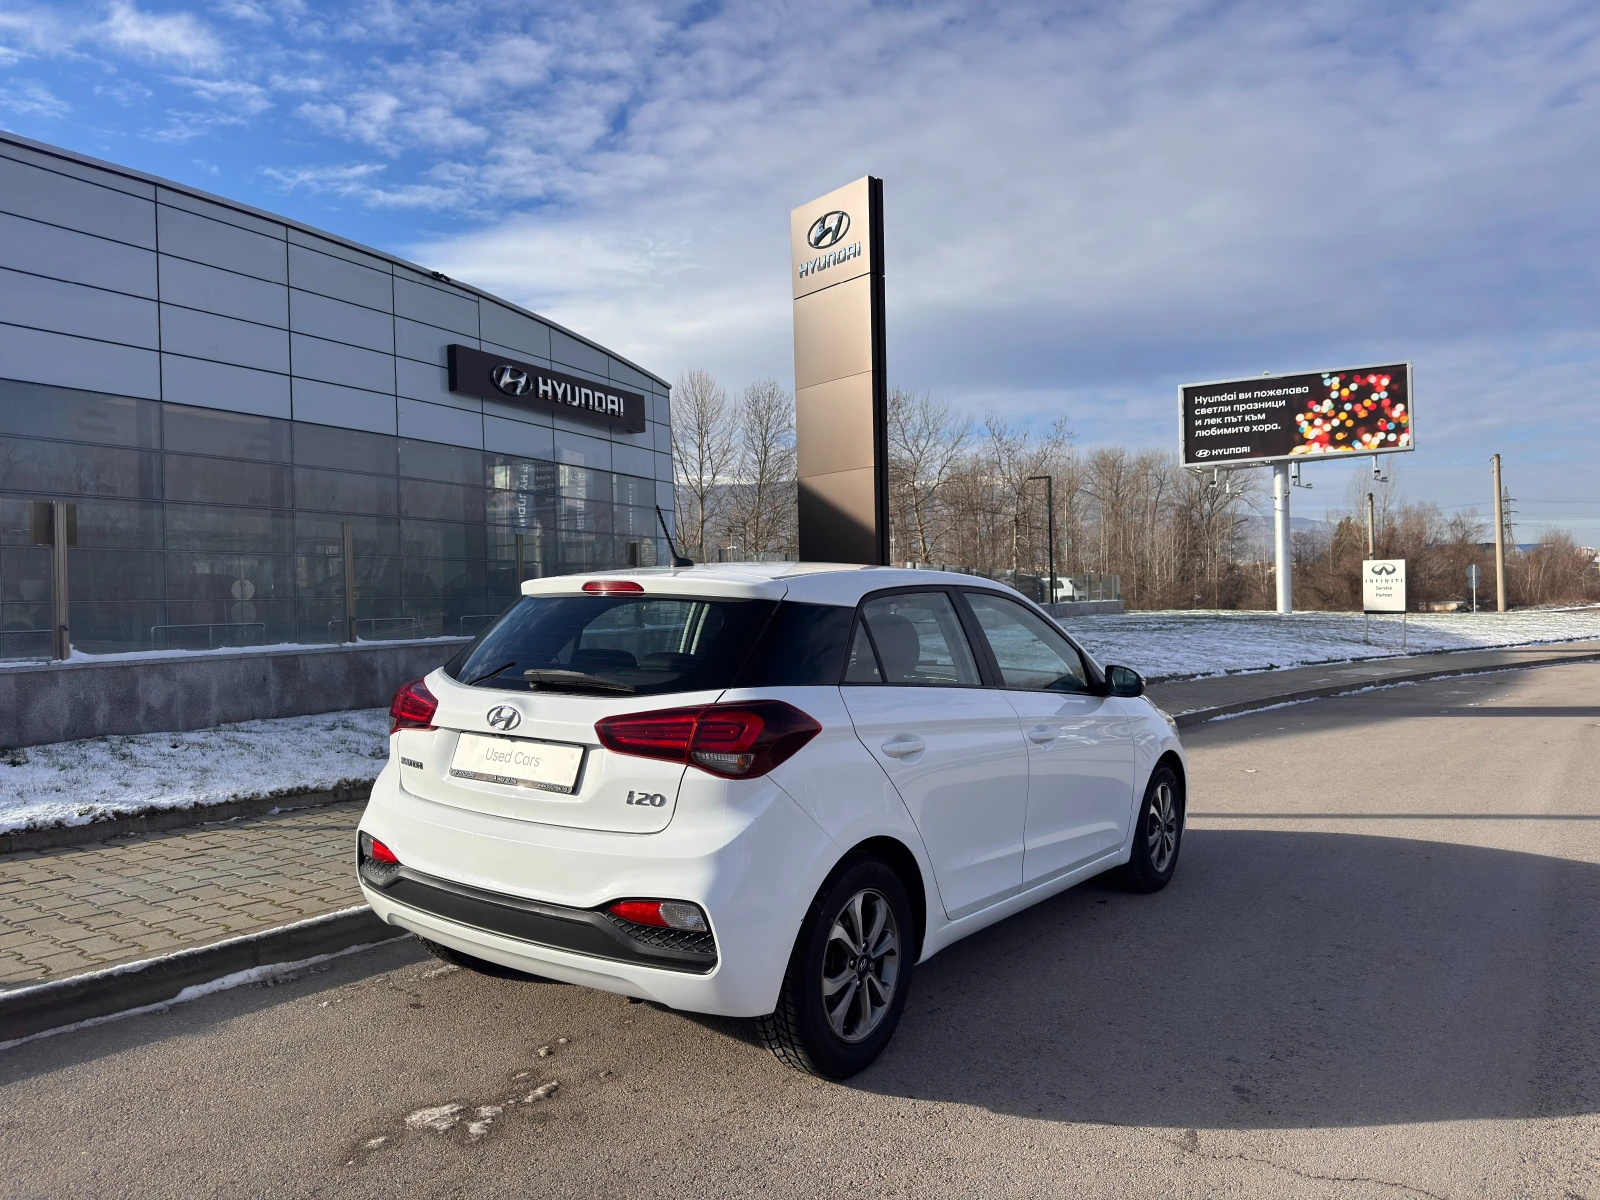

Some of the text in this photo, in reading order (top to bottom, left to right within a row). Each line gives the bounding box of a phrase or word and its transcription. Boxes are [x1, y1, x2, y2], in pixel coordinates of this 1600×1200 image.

[799, 241, 861, 278] HYUNDAI
[538, 376, 624, 417] HYUNDAI
[1195, 386, 1309, 405] Hyundai ви пожелава
[1195, 400, 1286, 415] светли празници
[1204, 417, 1223, 425] лек
[1224, 415, 1243, 424] път
[1245, 413, 1266, 421] към
[1195, 423, 1281, 437] любимите хора.
[1212, 446, 1250, 456] HYUNDAI
[486, 748, 541, 767] Used Cars
[626, 791, 667, 807] i20
